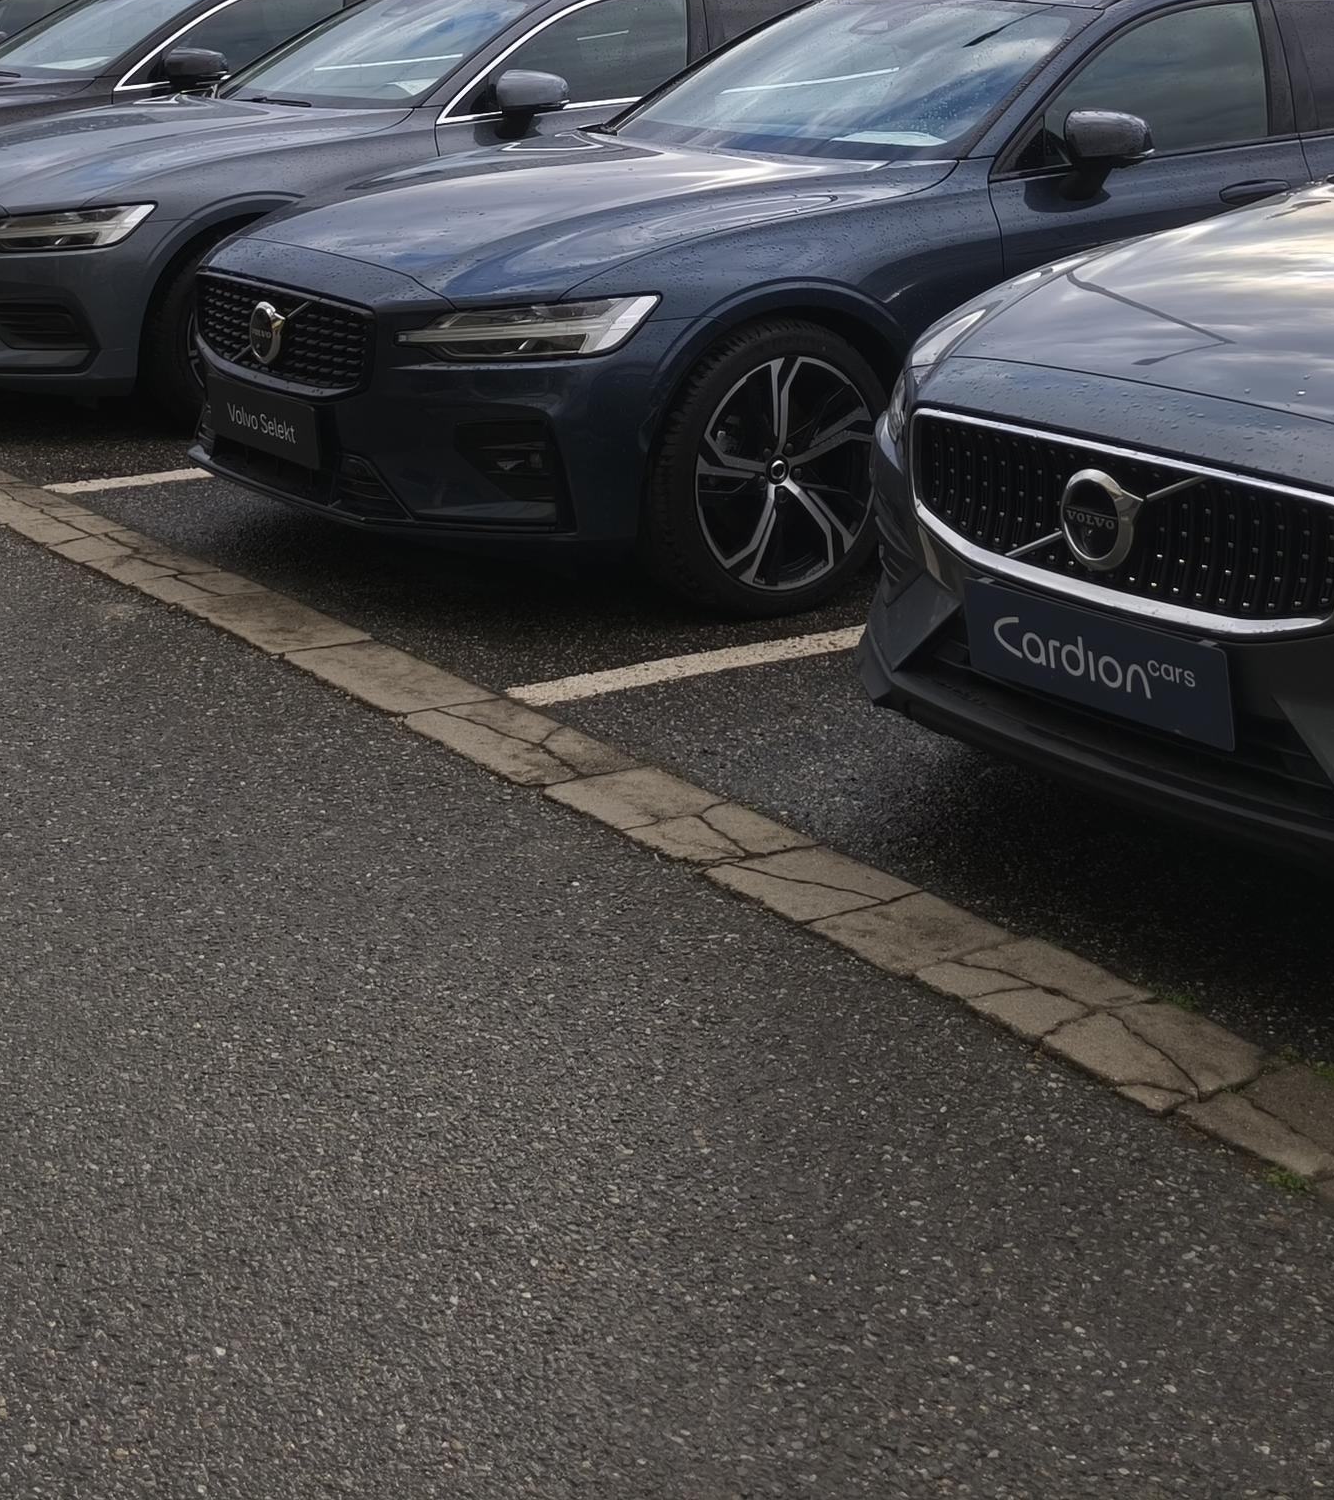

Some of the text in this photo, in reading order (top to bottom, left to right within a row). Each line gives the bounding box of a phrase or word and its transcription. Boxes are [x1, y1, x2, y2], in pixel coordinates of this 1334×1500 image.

[226, 401, 297, 445] Volvo Selekt
[1066, 510, 1116, 530] VOLVO
[993, 616, 1196, 699] Cardion cars
